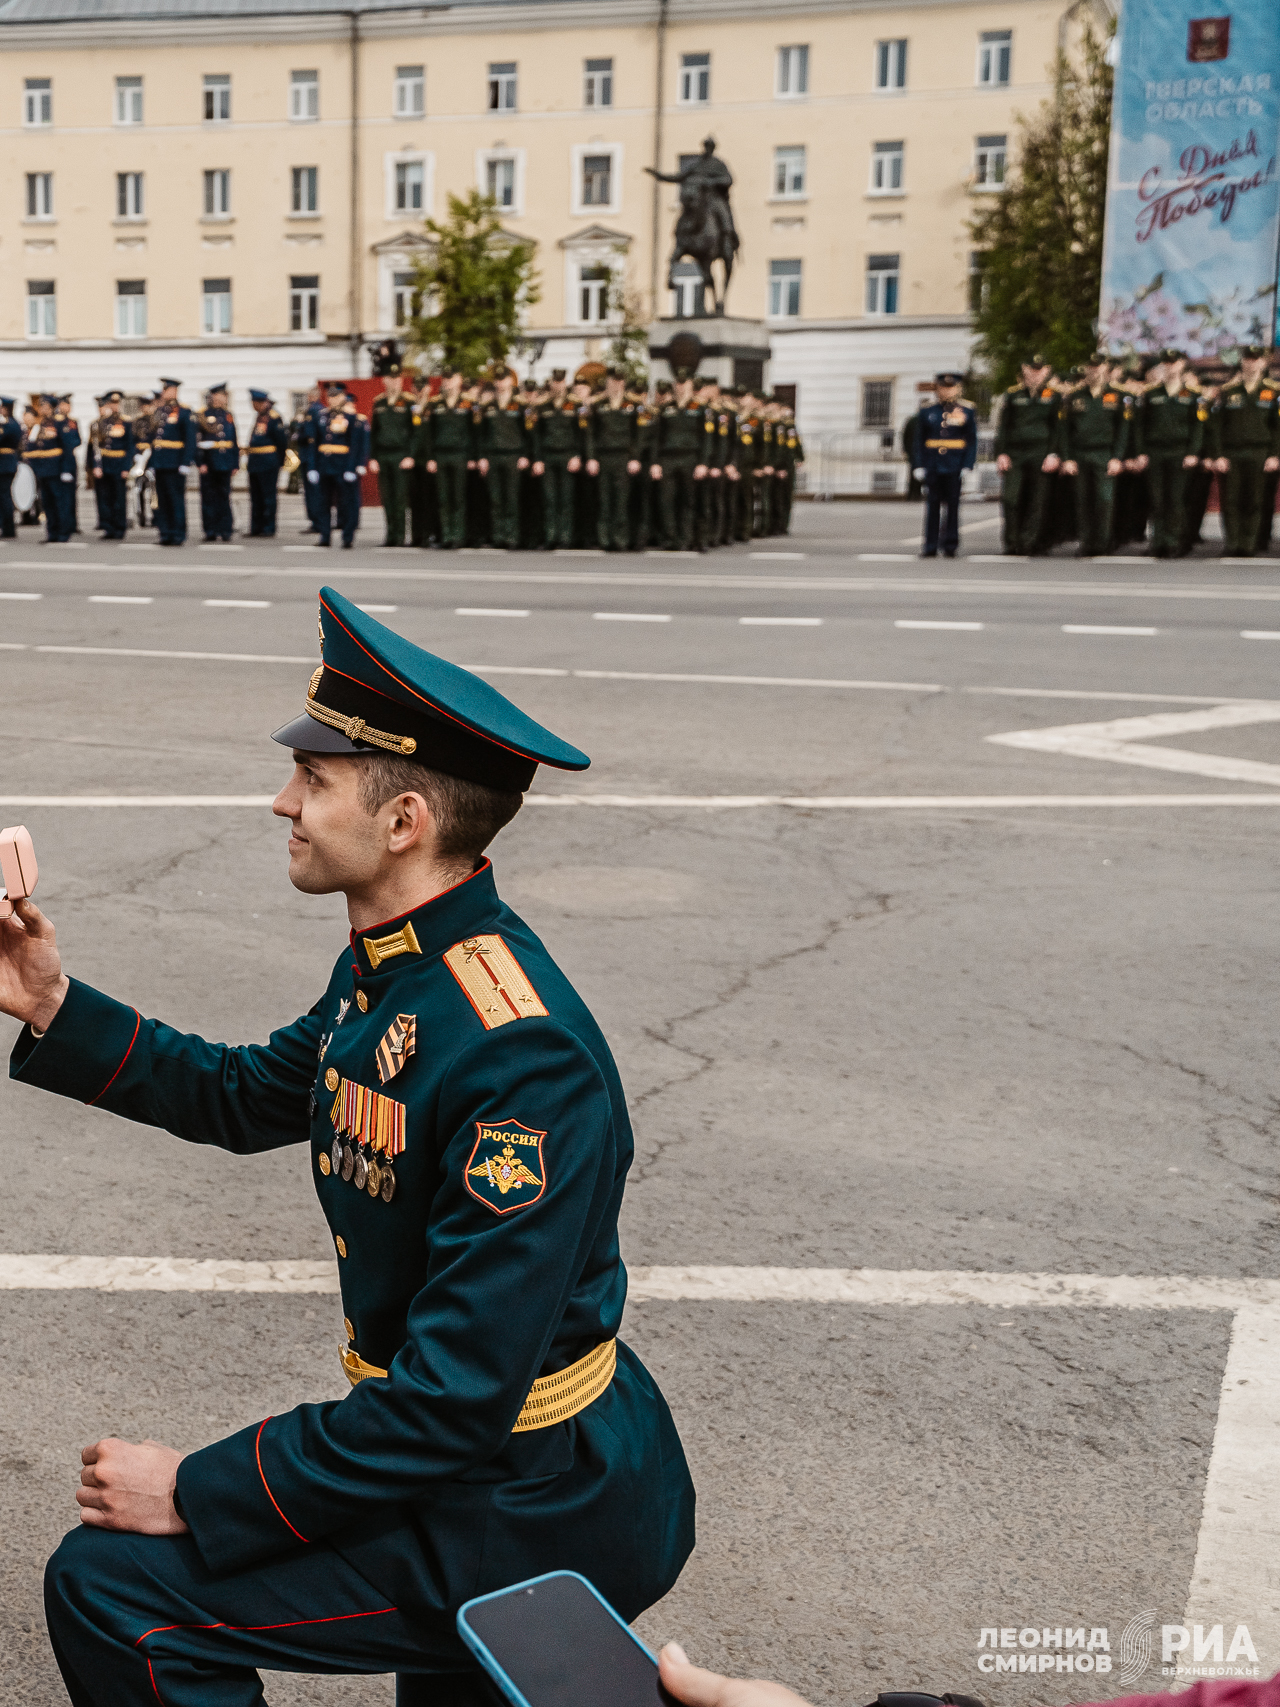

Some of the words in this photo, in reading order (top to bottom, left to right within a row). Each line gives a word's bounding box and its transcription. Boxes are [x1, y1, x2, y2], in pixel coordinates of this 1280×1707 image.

[1145, 97, 1263, 122] ОБЛАСТЬ
[1138, 165, 1161, 201] С
[482, 1129, 539, 1147] РОССИЯ
